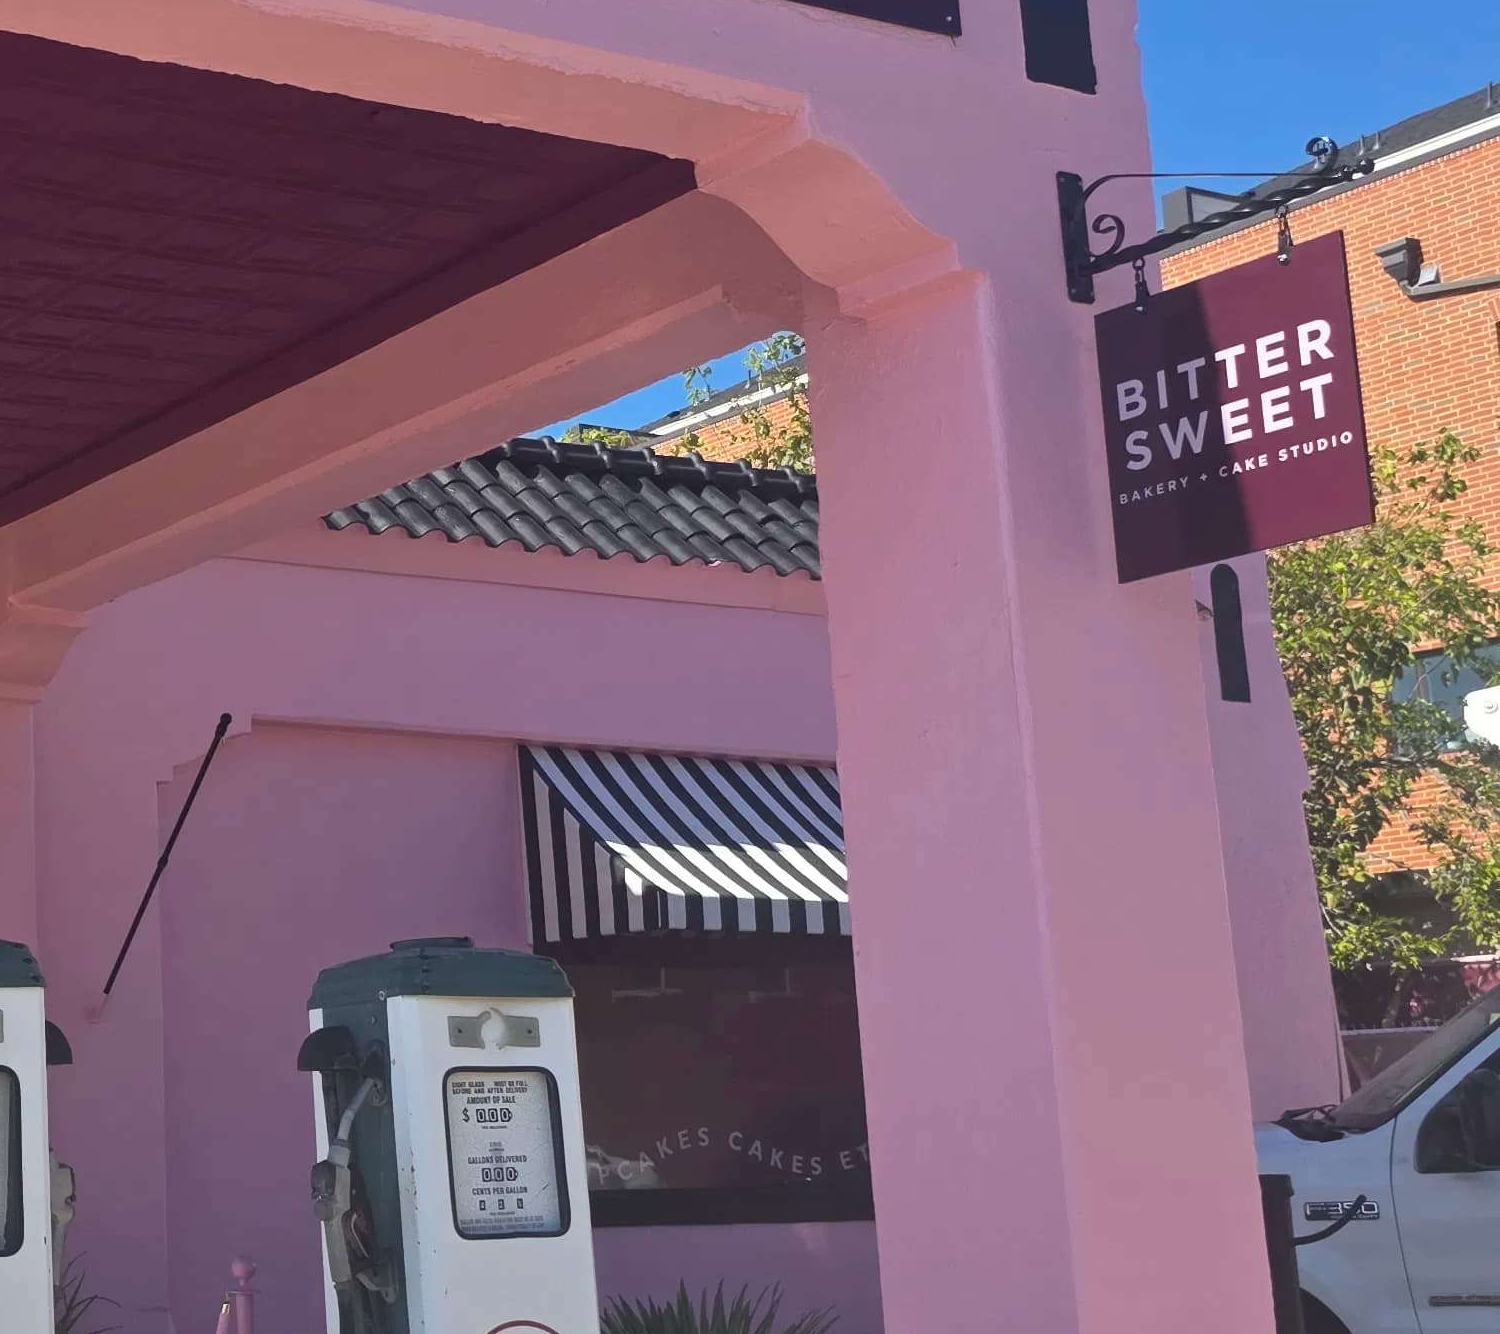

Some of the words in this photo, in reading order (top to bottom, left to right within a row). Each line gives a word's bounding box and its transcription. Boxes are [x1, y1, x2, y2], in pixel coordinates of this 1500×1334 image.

[1116, 319, 1334, 422] BITTER
[1125, 373, 1333, 471] SWEET
[1119, 476, 1189, 505] BAKERY
[1218, 452, 1269, 478] CAKE
[1278, 430, 1355, 463] STUDIO
[462, 1107, 470, 1123] $
[467, 1096, 491, 1104] AMOUNT
[492, 1096, 500, 1104] OF
[501, 1096, 516, 1104] SALE
[468, 1155, 493, 1164] GALLONS
[494, 1155, 527, 1163] DELIVERED
[728, 1131, 822, 1175] CAKES
[472, 1187, 491, 1196] CENTS
[492, 1187, 504, 1195] PER
[506, 1186, 528, 1194] GALLON
